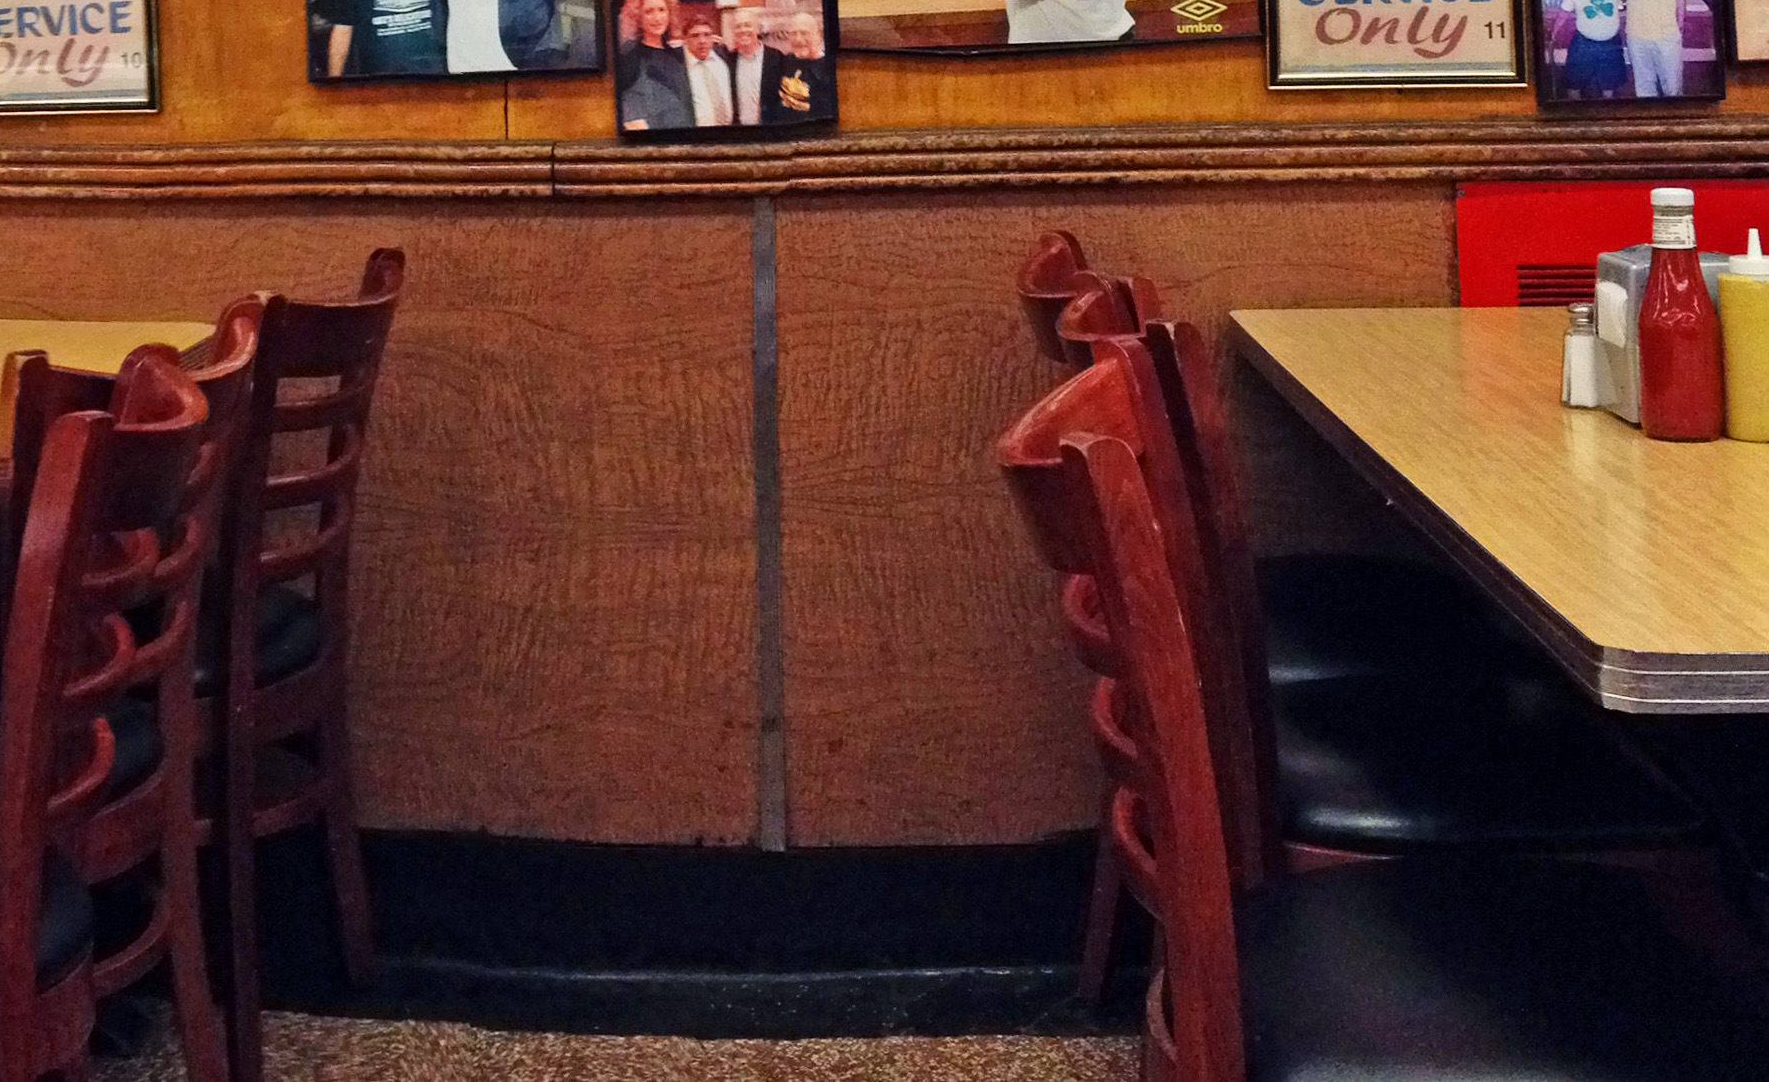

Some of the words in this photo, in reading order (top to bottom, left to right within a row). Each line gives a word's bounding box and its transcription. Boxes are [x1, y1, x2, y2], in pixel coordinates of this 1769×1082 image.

[1176, 21, 1224, 34] umbro
[1315, 6, 1468, 59] Only
[1484, 21, 1506, 39] 11
[120, 51, 143, 69] 10
